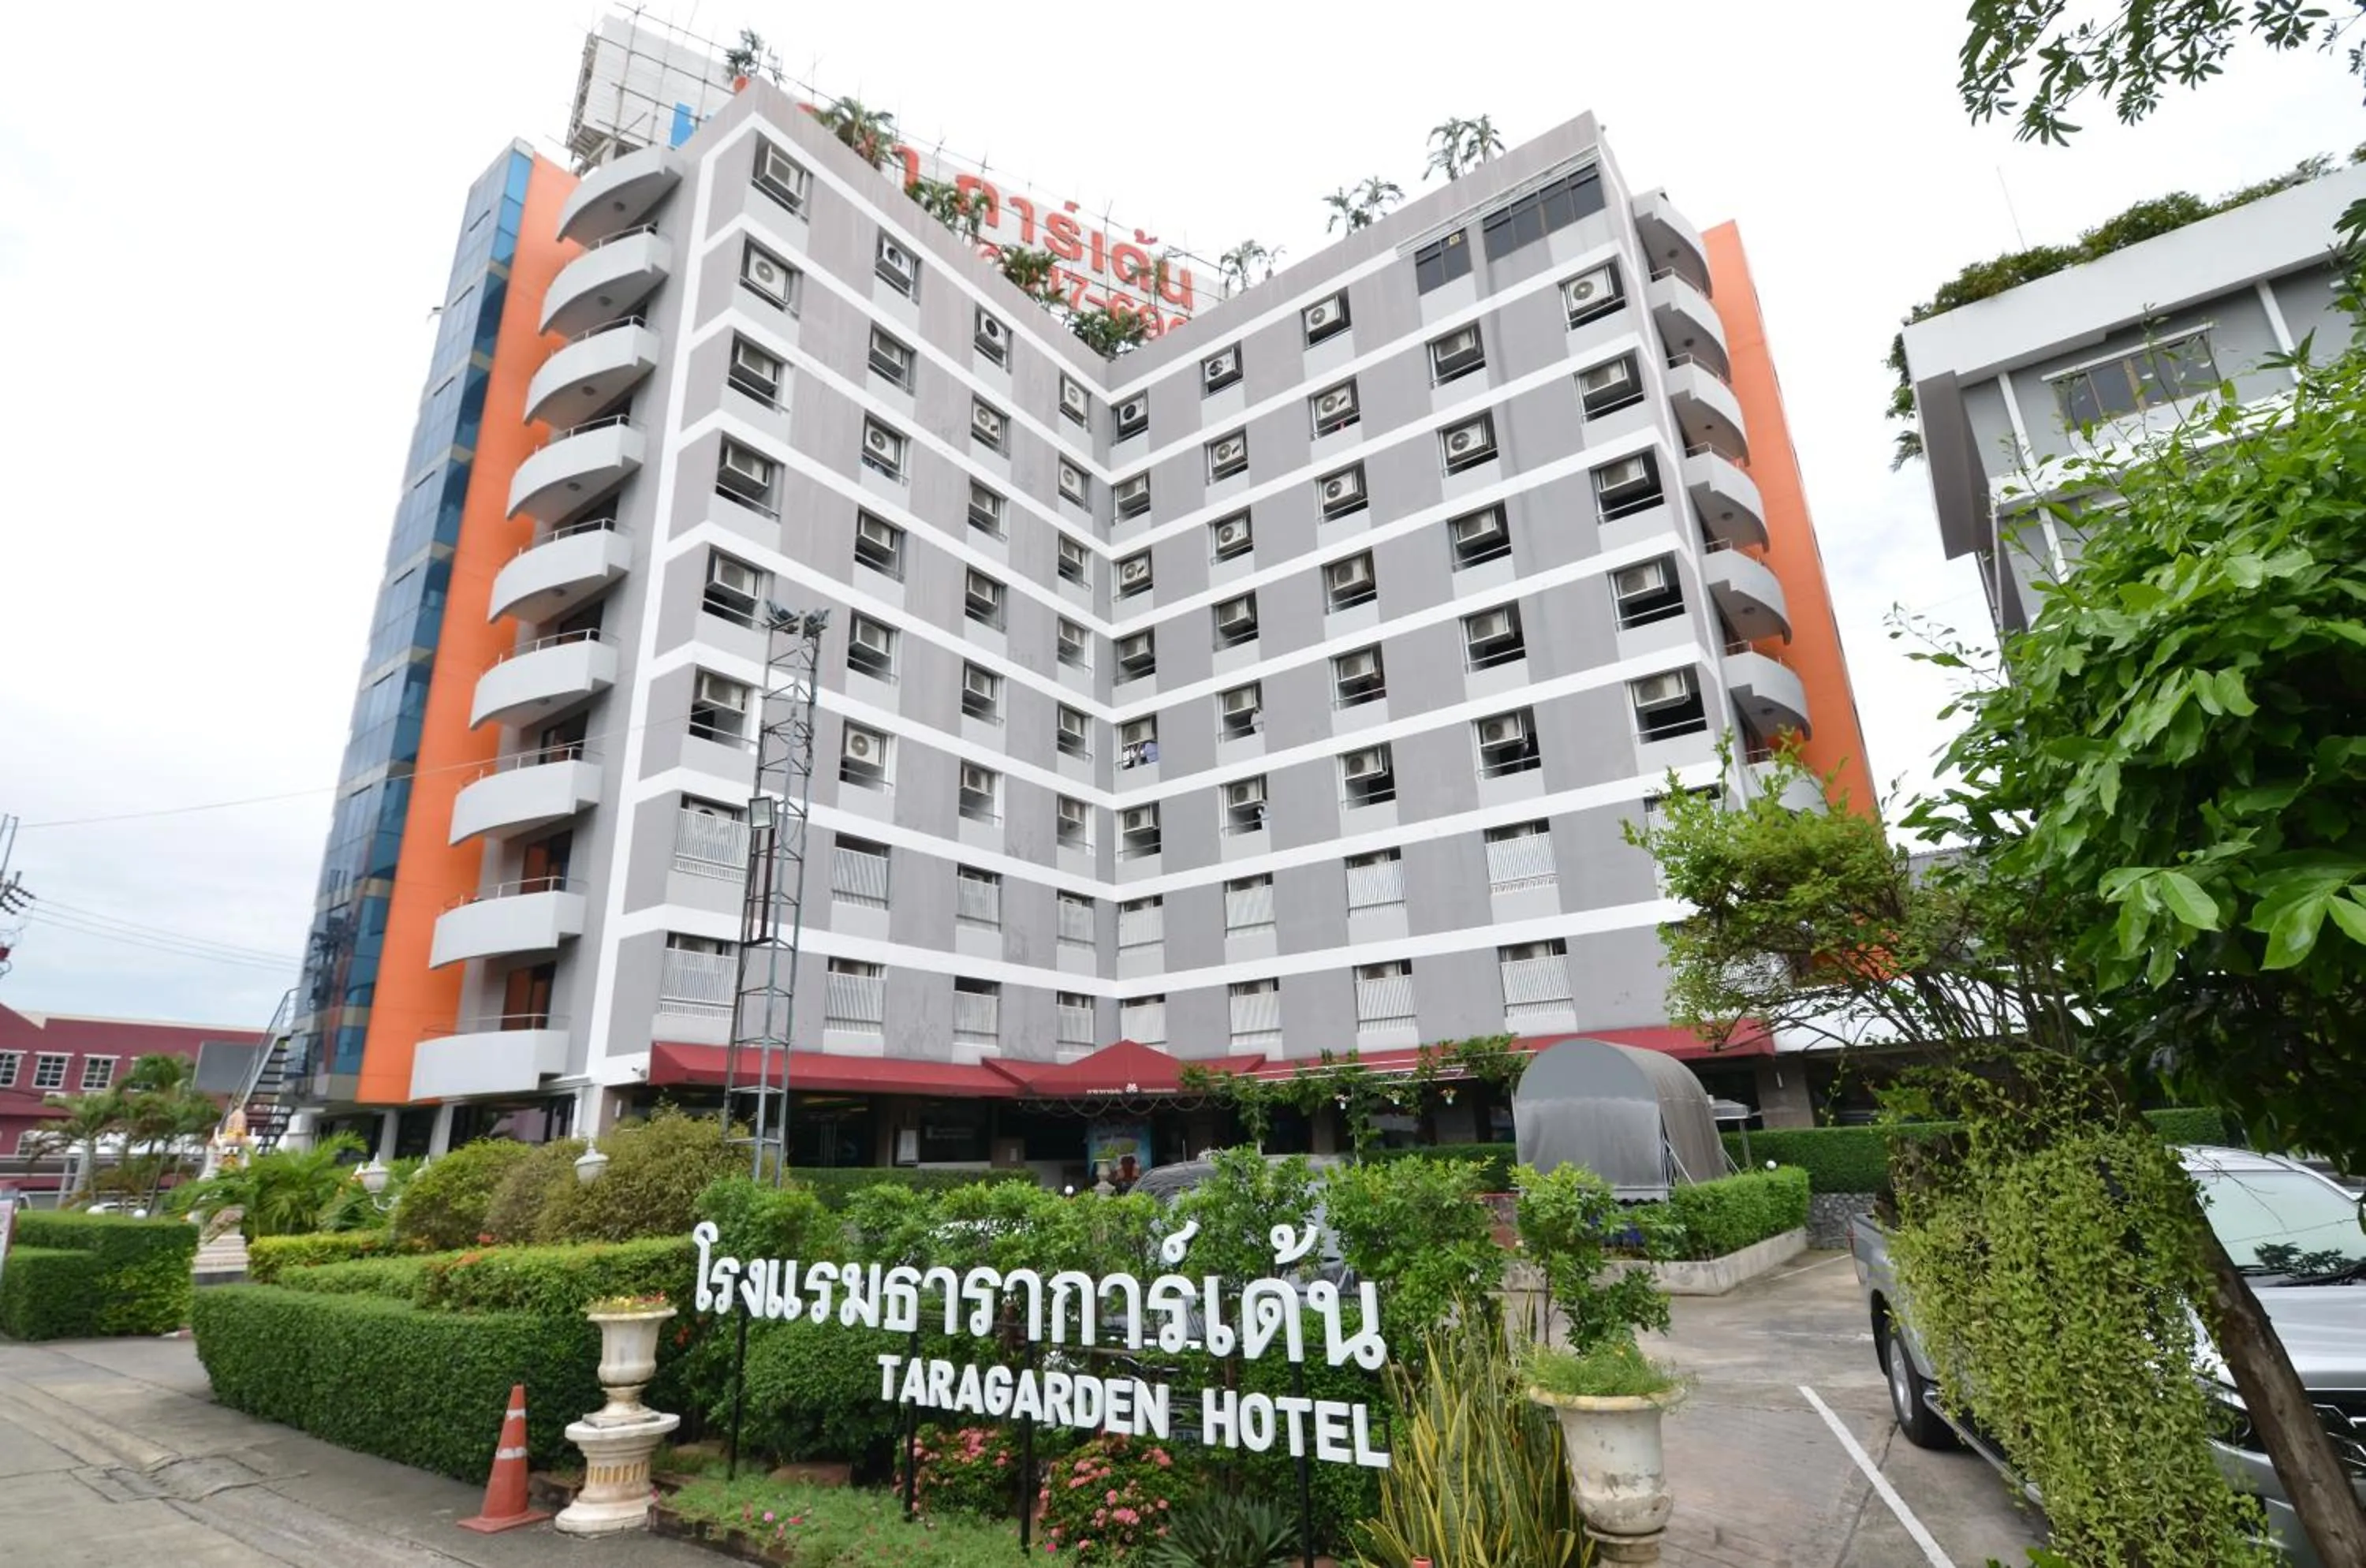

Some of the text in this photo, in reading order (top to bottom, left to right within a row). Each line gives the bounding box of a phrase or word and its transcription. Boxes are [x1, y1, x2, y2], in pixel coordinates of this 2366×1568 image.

[692, 1220, 1387, 1370] โรงแรมธาราการ์เด้น
[878, 1354, 1391, 1469] TARAGARDEN HOTEL
